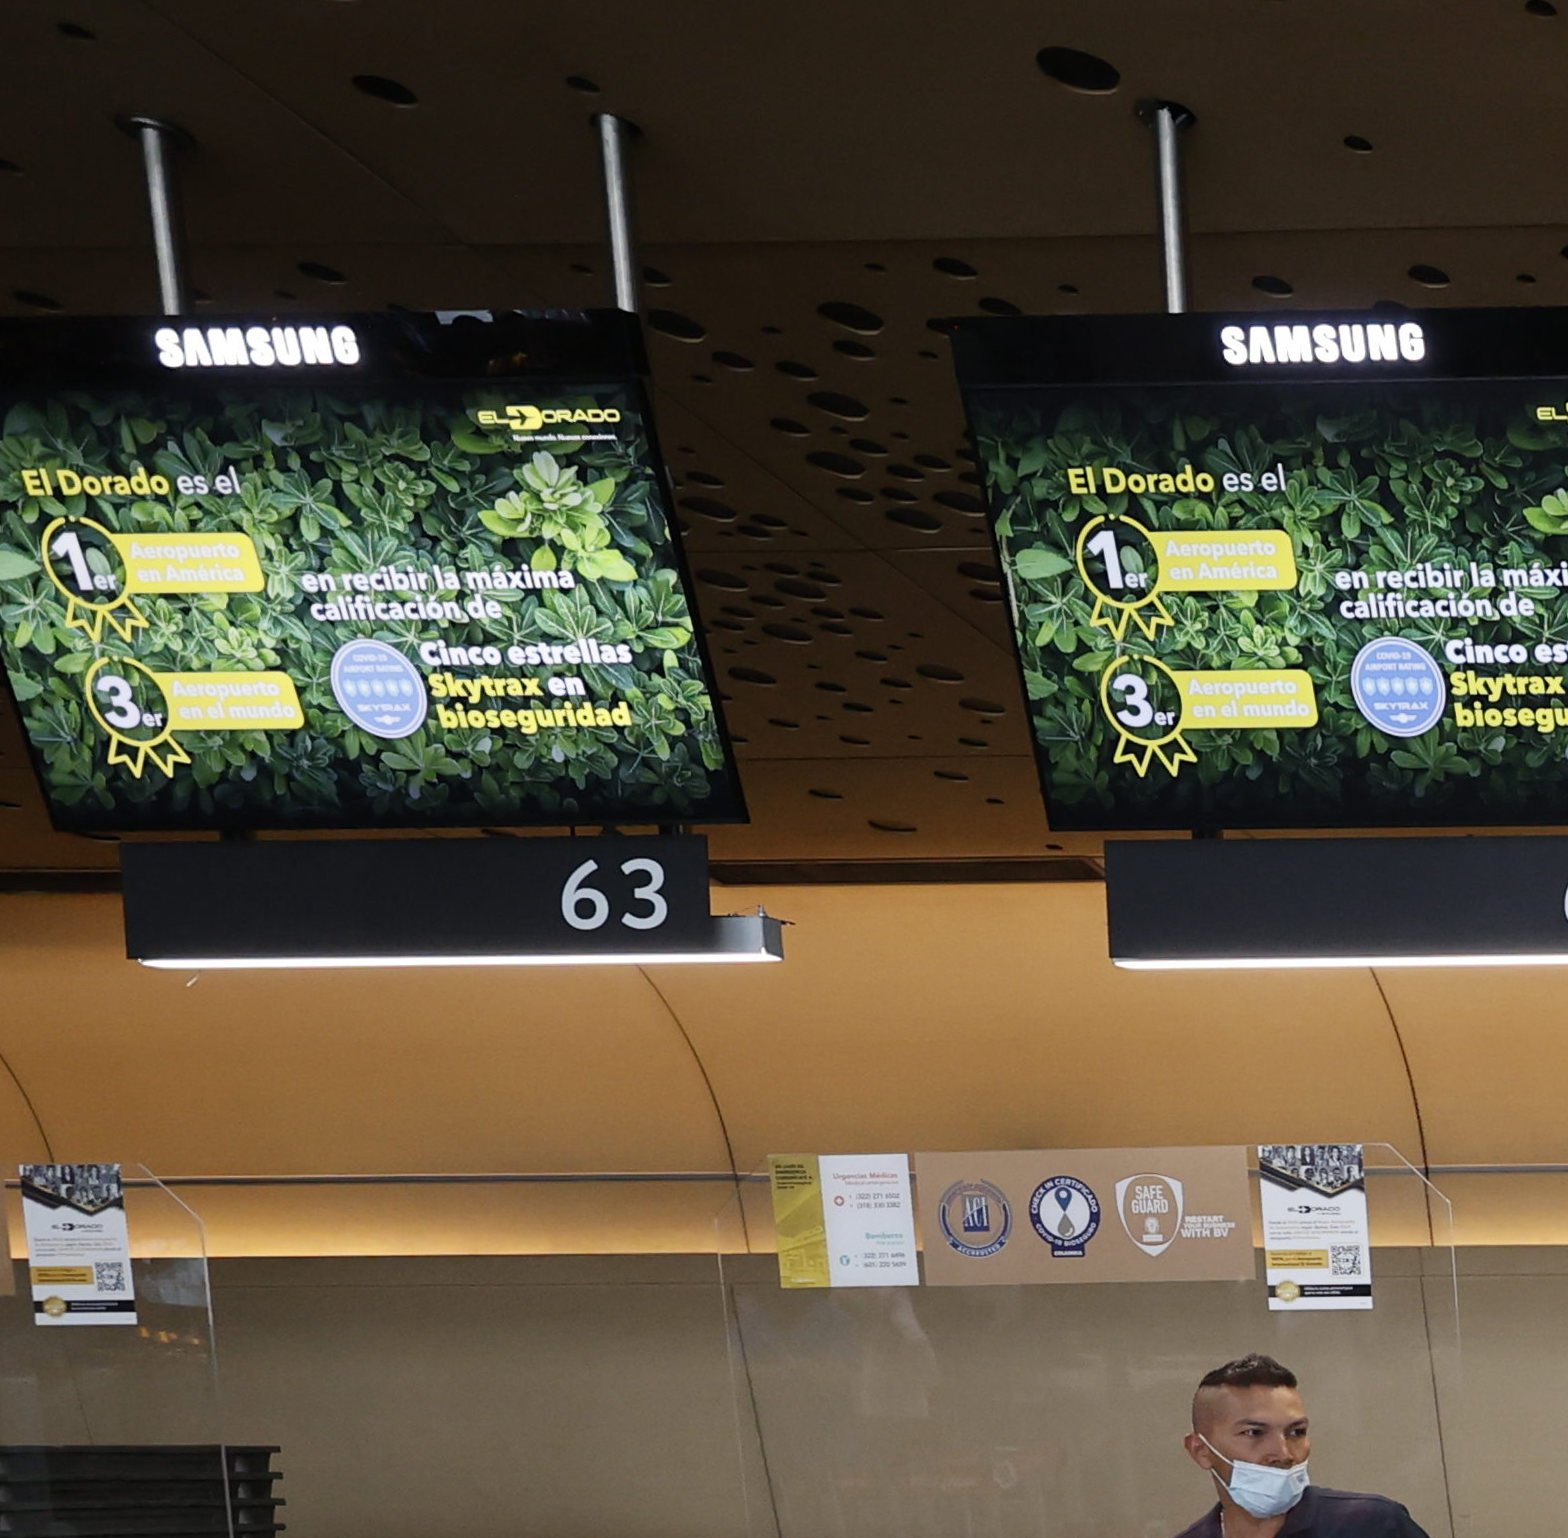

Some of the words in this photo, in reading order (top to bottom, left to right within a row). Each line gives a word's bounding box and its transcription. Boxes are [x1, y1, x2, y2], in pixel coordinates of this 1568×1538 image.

[155, 326, 361, 368] SAMSUNG
[1221, 322, 1426, 366] SAMSUNG
[22, 468, 53, 496] El
[57, 467, 169, 496] Dorado
[177, 474, 208, 495] es
[215, 466, 240, 494] el
[1067, 466, 1096, 494] El
[1103, 465, 1214, 494] Dorado
[1223, 471, 1254, 492] es
[1261, 463, 1286, 491] el
[1166, 541, 1276, 559] Aeropuerto
[302, 574, 335, 592] en
[342, 565, 429, 591] recibir
[435, 566, 460, 590] la
[467, 564, 575, 589] máxima
[1170, 567, 1194, 580] en
[1198, 563, 1278, 580] América
[1335, 571, 1368, 589] en
[1376, 562, 1464, 588] recibir
[1470, 562, 1496, 587] la
[310, 595, 461, 621] calificación
[468, 595, 502, 618] de
[1340, 592, 1492, 619] calificación
[1499, 592, 1535, 616] de
[419, 640, 500, 666] Cinco
[507, 639, 632, 664] estrellas
[1445, 637, 1528, 664] Cinco
[428, 673, 543, 702] Skytrax
[547, 676, 585, 696] en
[1189, 679, 1298, 697] Aeropuerto
[1450, 670, 1565, 702] Skytrax
[436, 702, 632, 734] bioseguridad
[1193, 704, 1216, 718] en
[1221, 700, 1238, 717] el
[1243, 700, 1311, 717] mundo
[562, 859, 668, 931] 63
[1031, 1186, 1047, 1214] CHECK
[1043, 1179, 1054, 1190] IN
[1055, 1177, 1098, 1213] CERTIFICADO
[1135, 1185, 1163, 1199] SAFE
[964, 1197, 989, 1227] ACI
[1131, 1199, 1168, 1214] GUARD
[1181, 1228, 1211, 1238] WITH
[1213, 1227, 1229, 1237] BV
